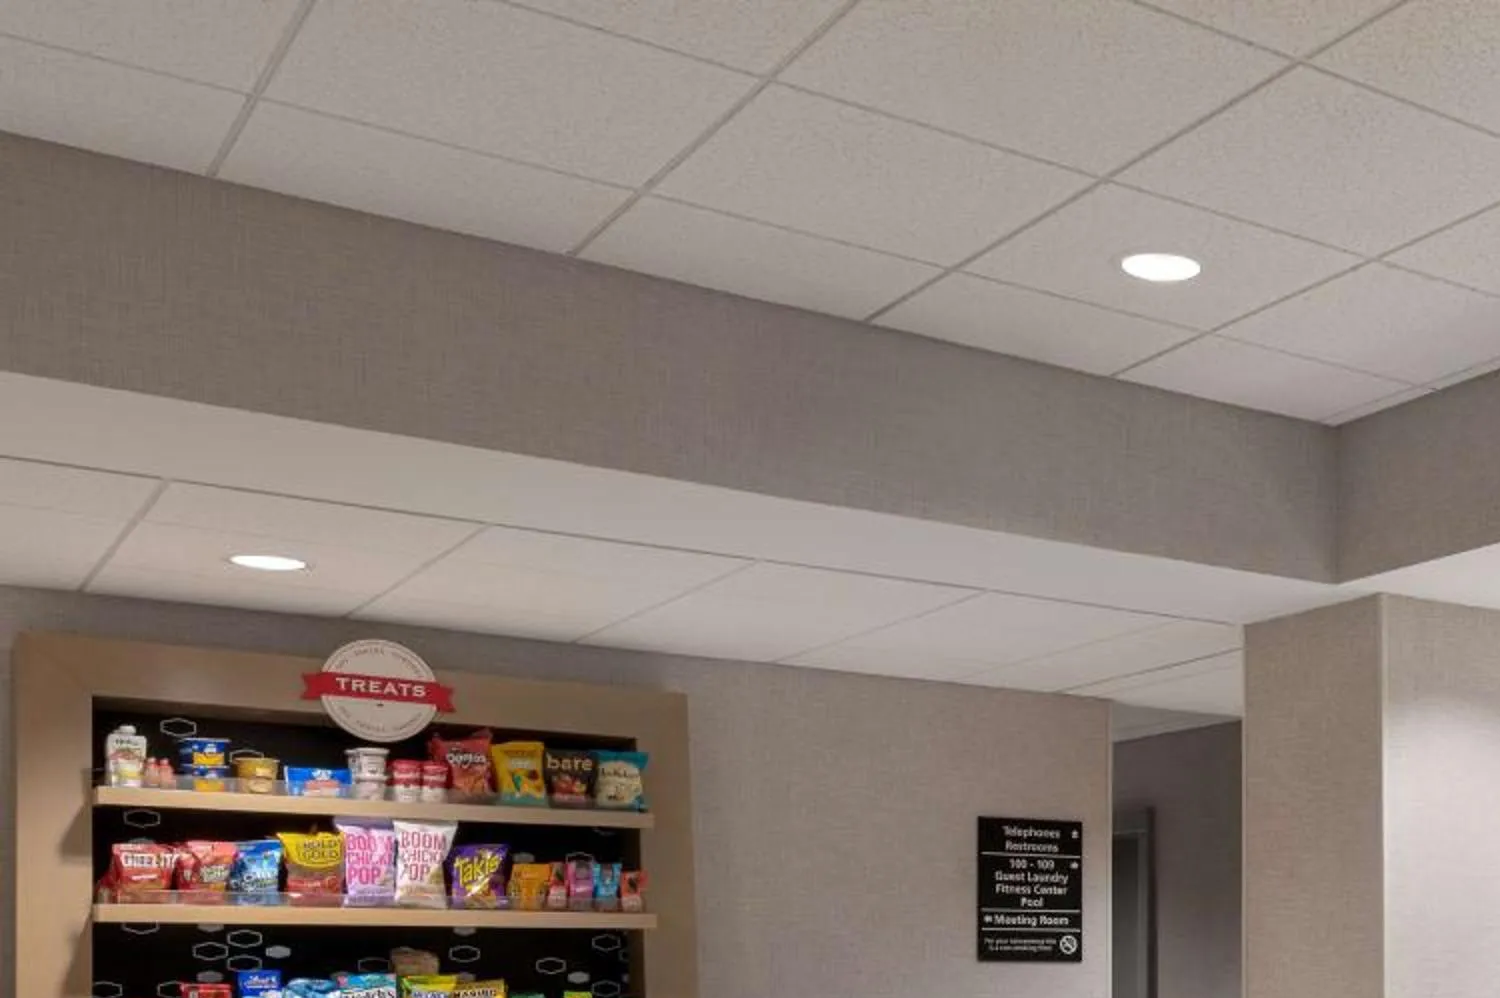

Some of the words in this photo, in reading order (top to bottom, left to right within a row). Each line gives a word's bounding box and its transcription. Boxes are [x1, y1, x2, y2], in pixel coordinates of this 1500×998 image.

[335, 677, 426, 697] TREATS
[546, 752, 593, 771] bare
[1002, 825, 1061, 839] Telephones
[401, 831, 446, 850] BOOM
[1005, 840, 1059, 853] Restrooms
[995, 870, 1025, 882] Guest
[1027, 871, 1069, 885] Laundry
[995, 883, 1031, 895] Fitness
[1034, 884, 1068, 895] Center
[1020, 897, 1044, 907] Pool
[994, 914, 1037, 927] Meeting
[1039, 915, 1070, 925] Room
